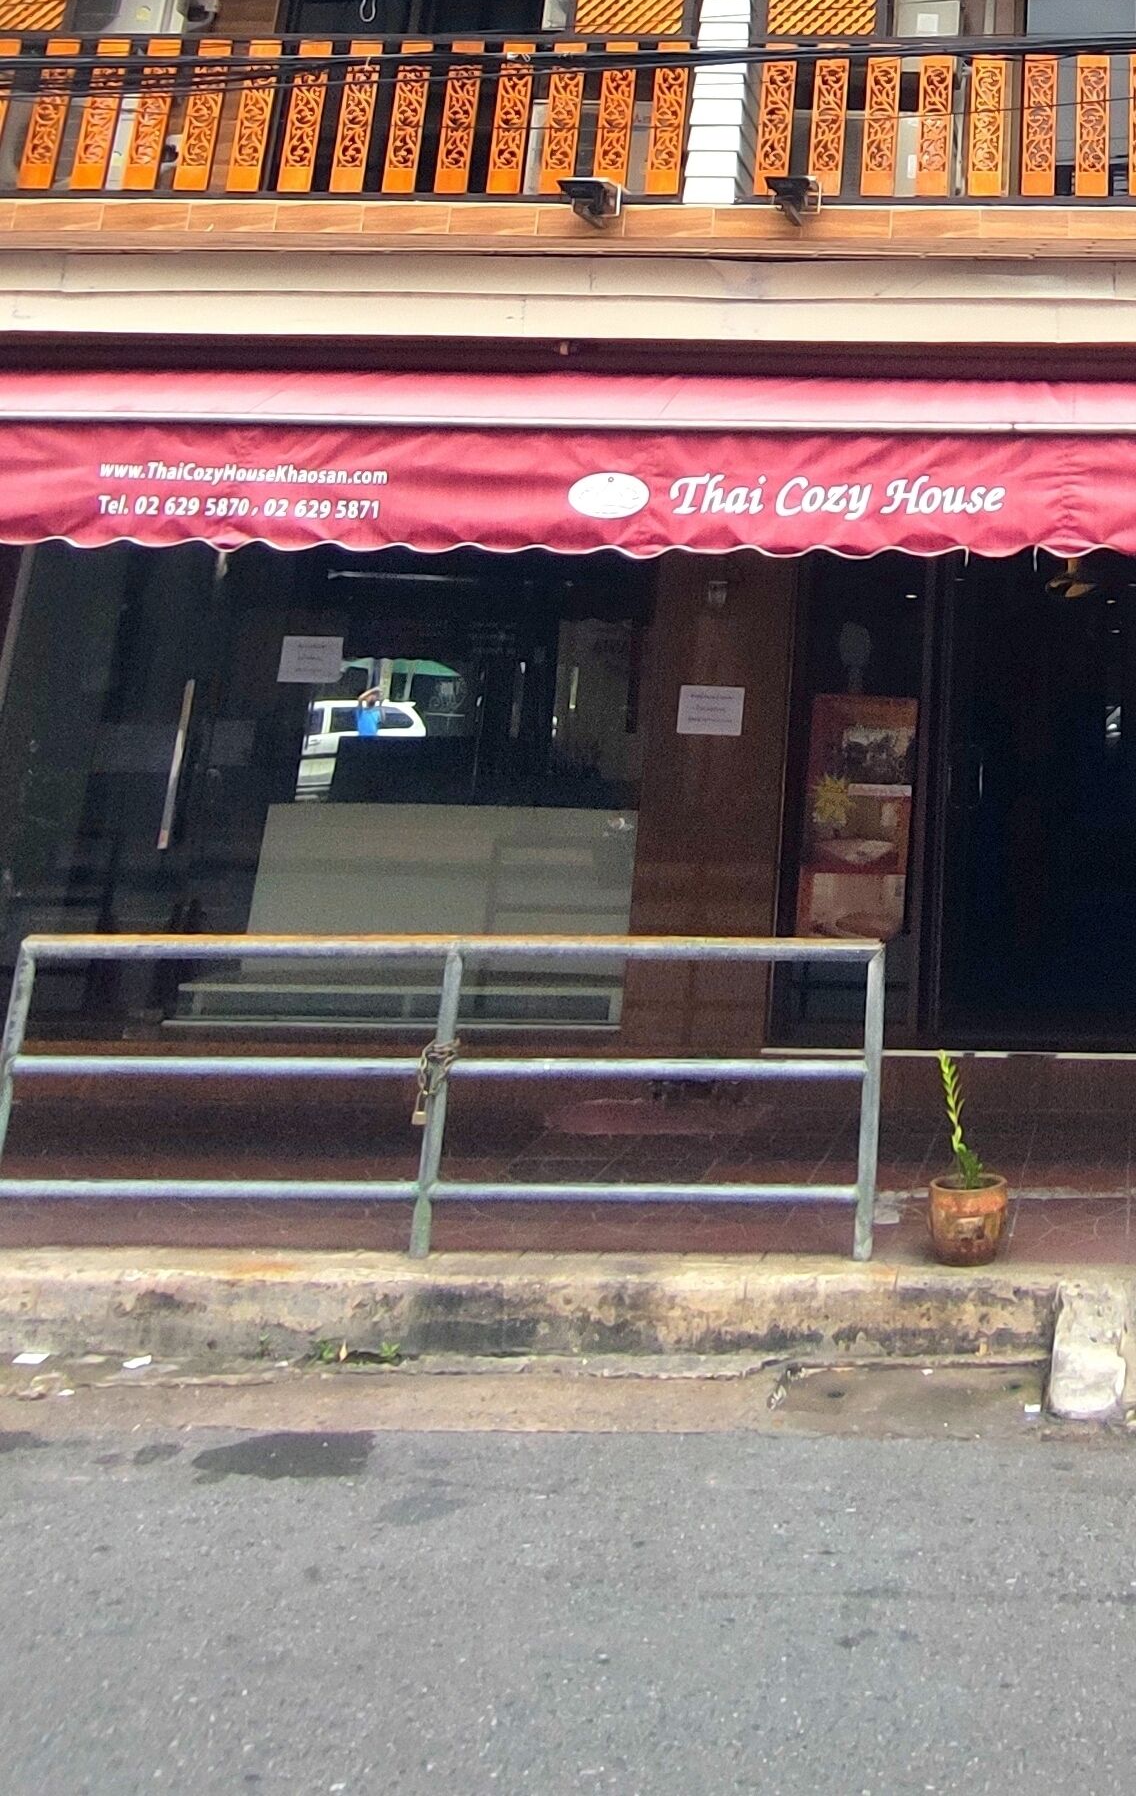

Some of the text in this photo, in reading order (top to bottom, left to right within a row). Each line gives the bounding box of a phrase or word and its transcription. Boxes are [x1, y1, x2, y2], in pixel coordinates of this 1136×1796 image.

[99, 461, 388, 486] www.ThaiCozyHouseKhaosan.com
[98, 494, 129, 515] Tel.
[134, 495, 159, 515] 02
[164, 496, 200, 516] 629
[263, 498, 289, 518] 02
[294, 499, 331, 519] 629
[334, 500, 380, 519] 5871
[669, 472, 1006, 521] Thai Cozy House
